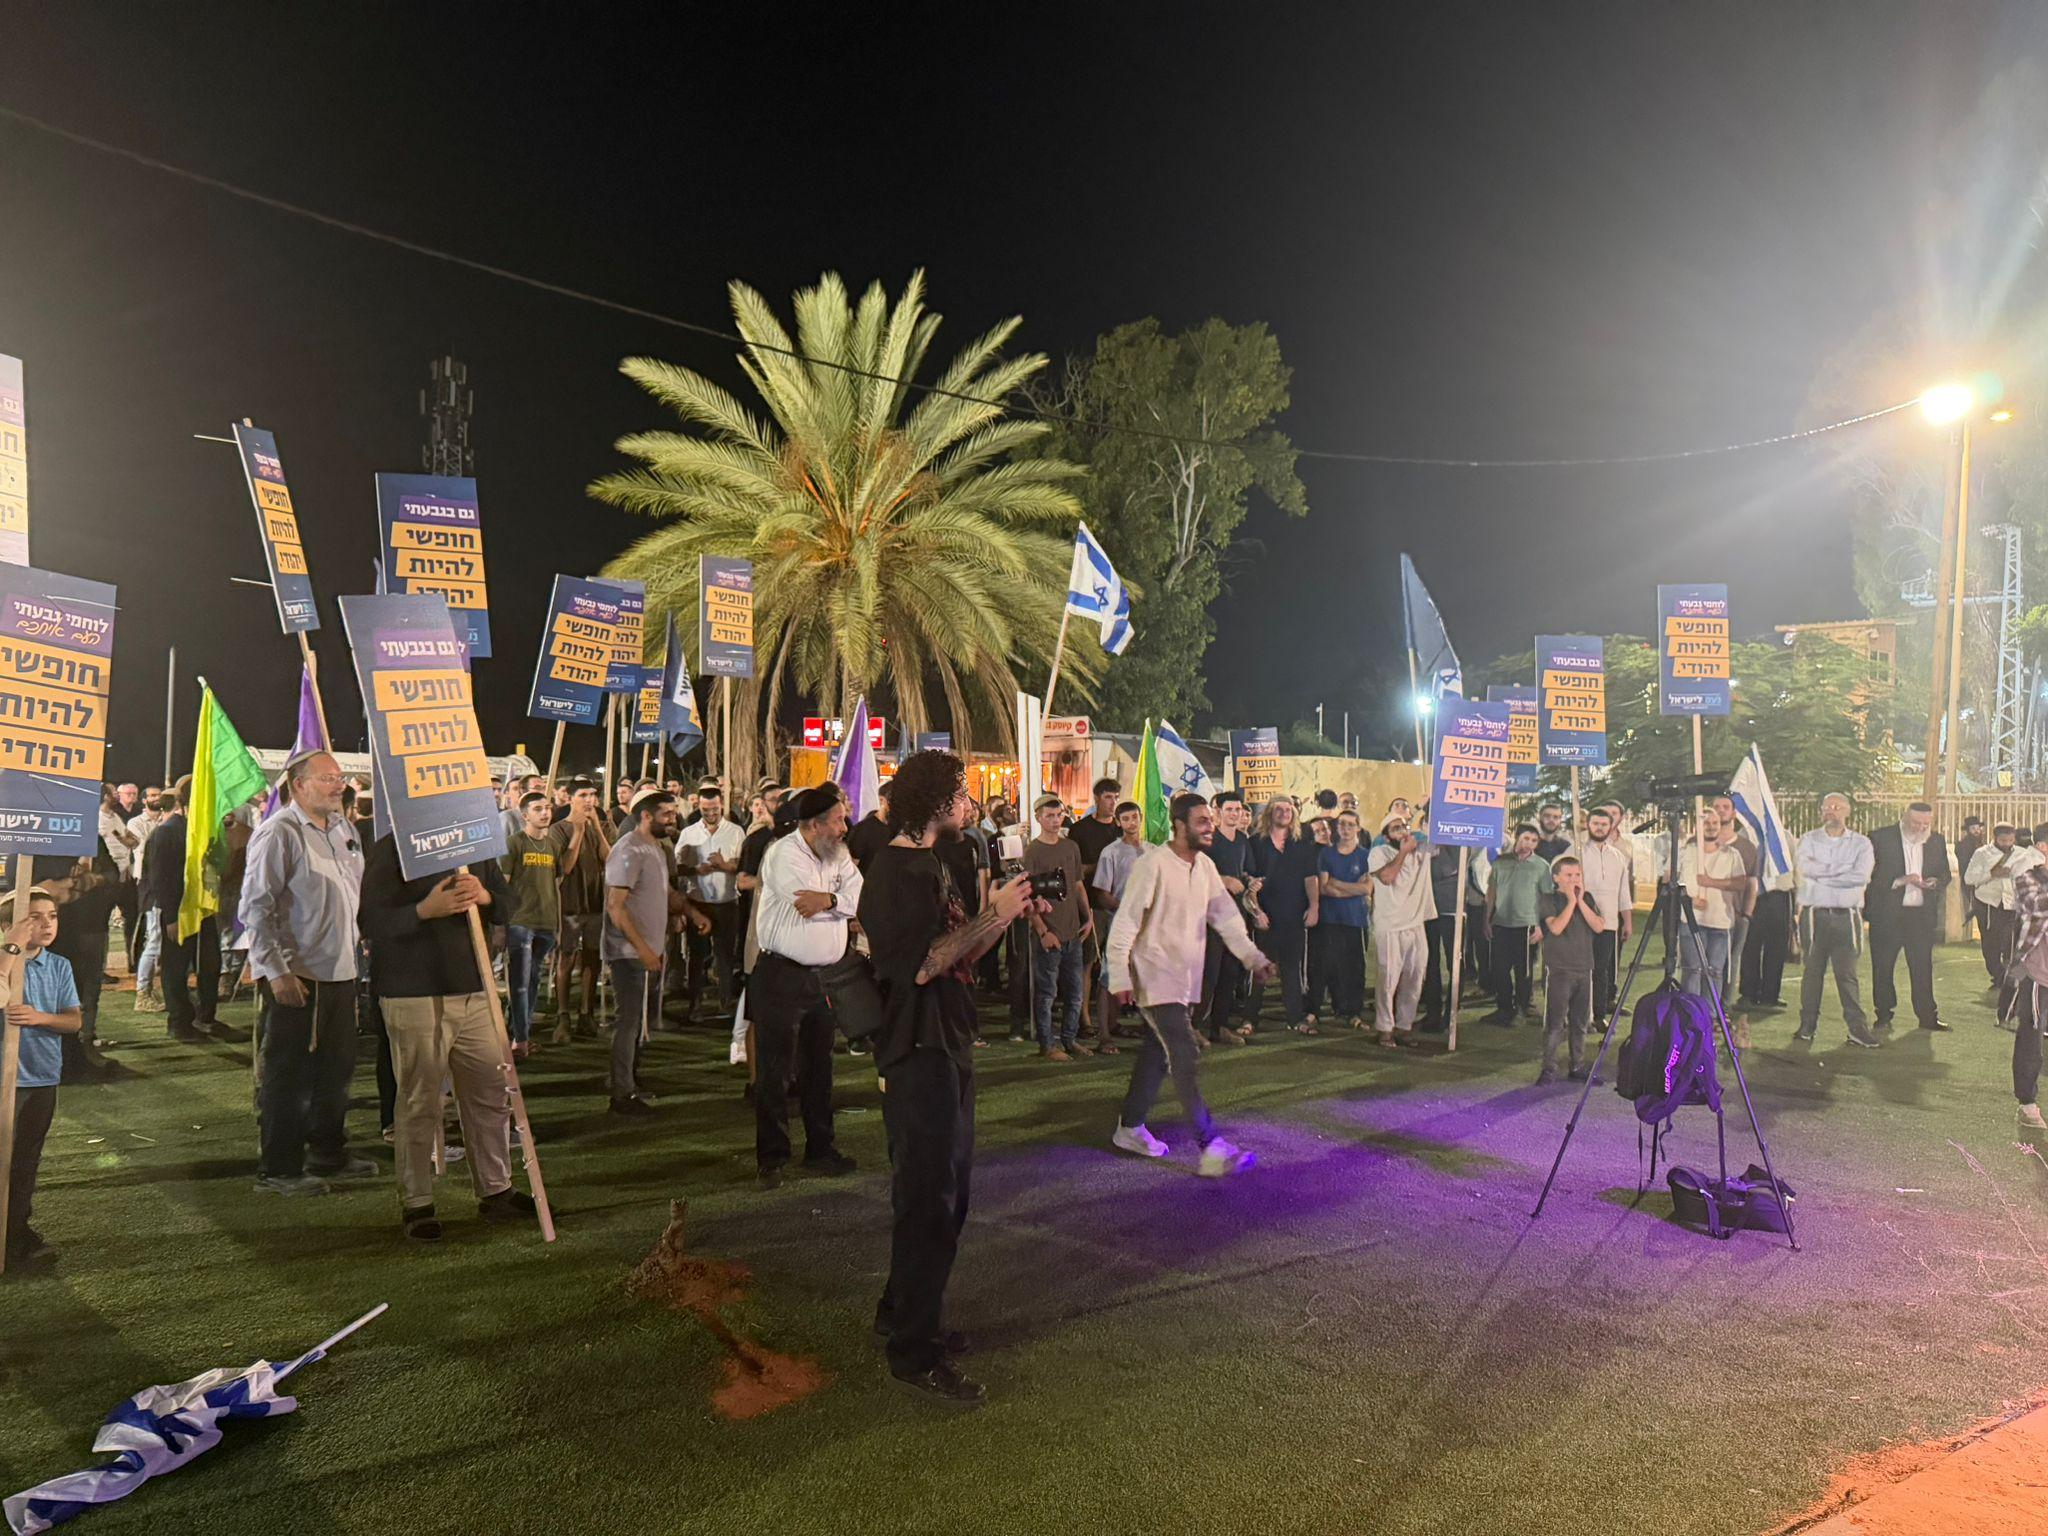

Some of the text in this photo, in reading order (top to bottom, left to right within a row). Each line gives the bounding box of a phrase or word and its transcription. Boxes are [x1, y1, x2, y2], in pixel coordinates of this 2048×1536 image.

[404, 503, 475, 520] גם בגבעתי
[270, 518, 295, 539] להיות
[406, 529, 474, 549] חופשי
[409, 558, 474, 577] להיות
[714, 590, 749, 606] חופשי
[14, 601, 109, 633] לוחמי גבעתי
[714, 609, 747, 624] להיות
[565, 619, 611, 641] חופשי
[1676, 622, 1723, 634] חופשי
[380, 640, 438, 658] בגבעתי
[437, 641, 456, 657] גם
[560, 641, 605, 662] להיות
[1677, 641, 1722, 654] להיות
[1, 645, 100, 688] חופשי
[1589, 658, 1601, 667] גם
[1553, 674, 1599, 688] חופשי
[390, 678, 464, 702] חופשי
[539, 695, 574, 711] לישראל
[1554, 695, 1598, 708] להיות
[401, 714, 468, 747] להיות
[1453, 742, 1502, 759] חופשי
[1546, 744, 1579, 755] לישראל
[1243, 759, 1276, 768] חופשי
[1245, 772, 1276, 785] להיות
[1450, 764, 1499, 781] להיות
[1437, 821, 1474, 834] לישראל
[410, 828, 464, 853] לישראל
